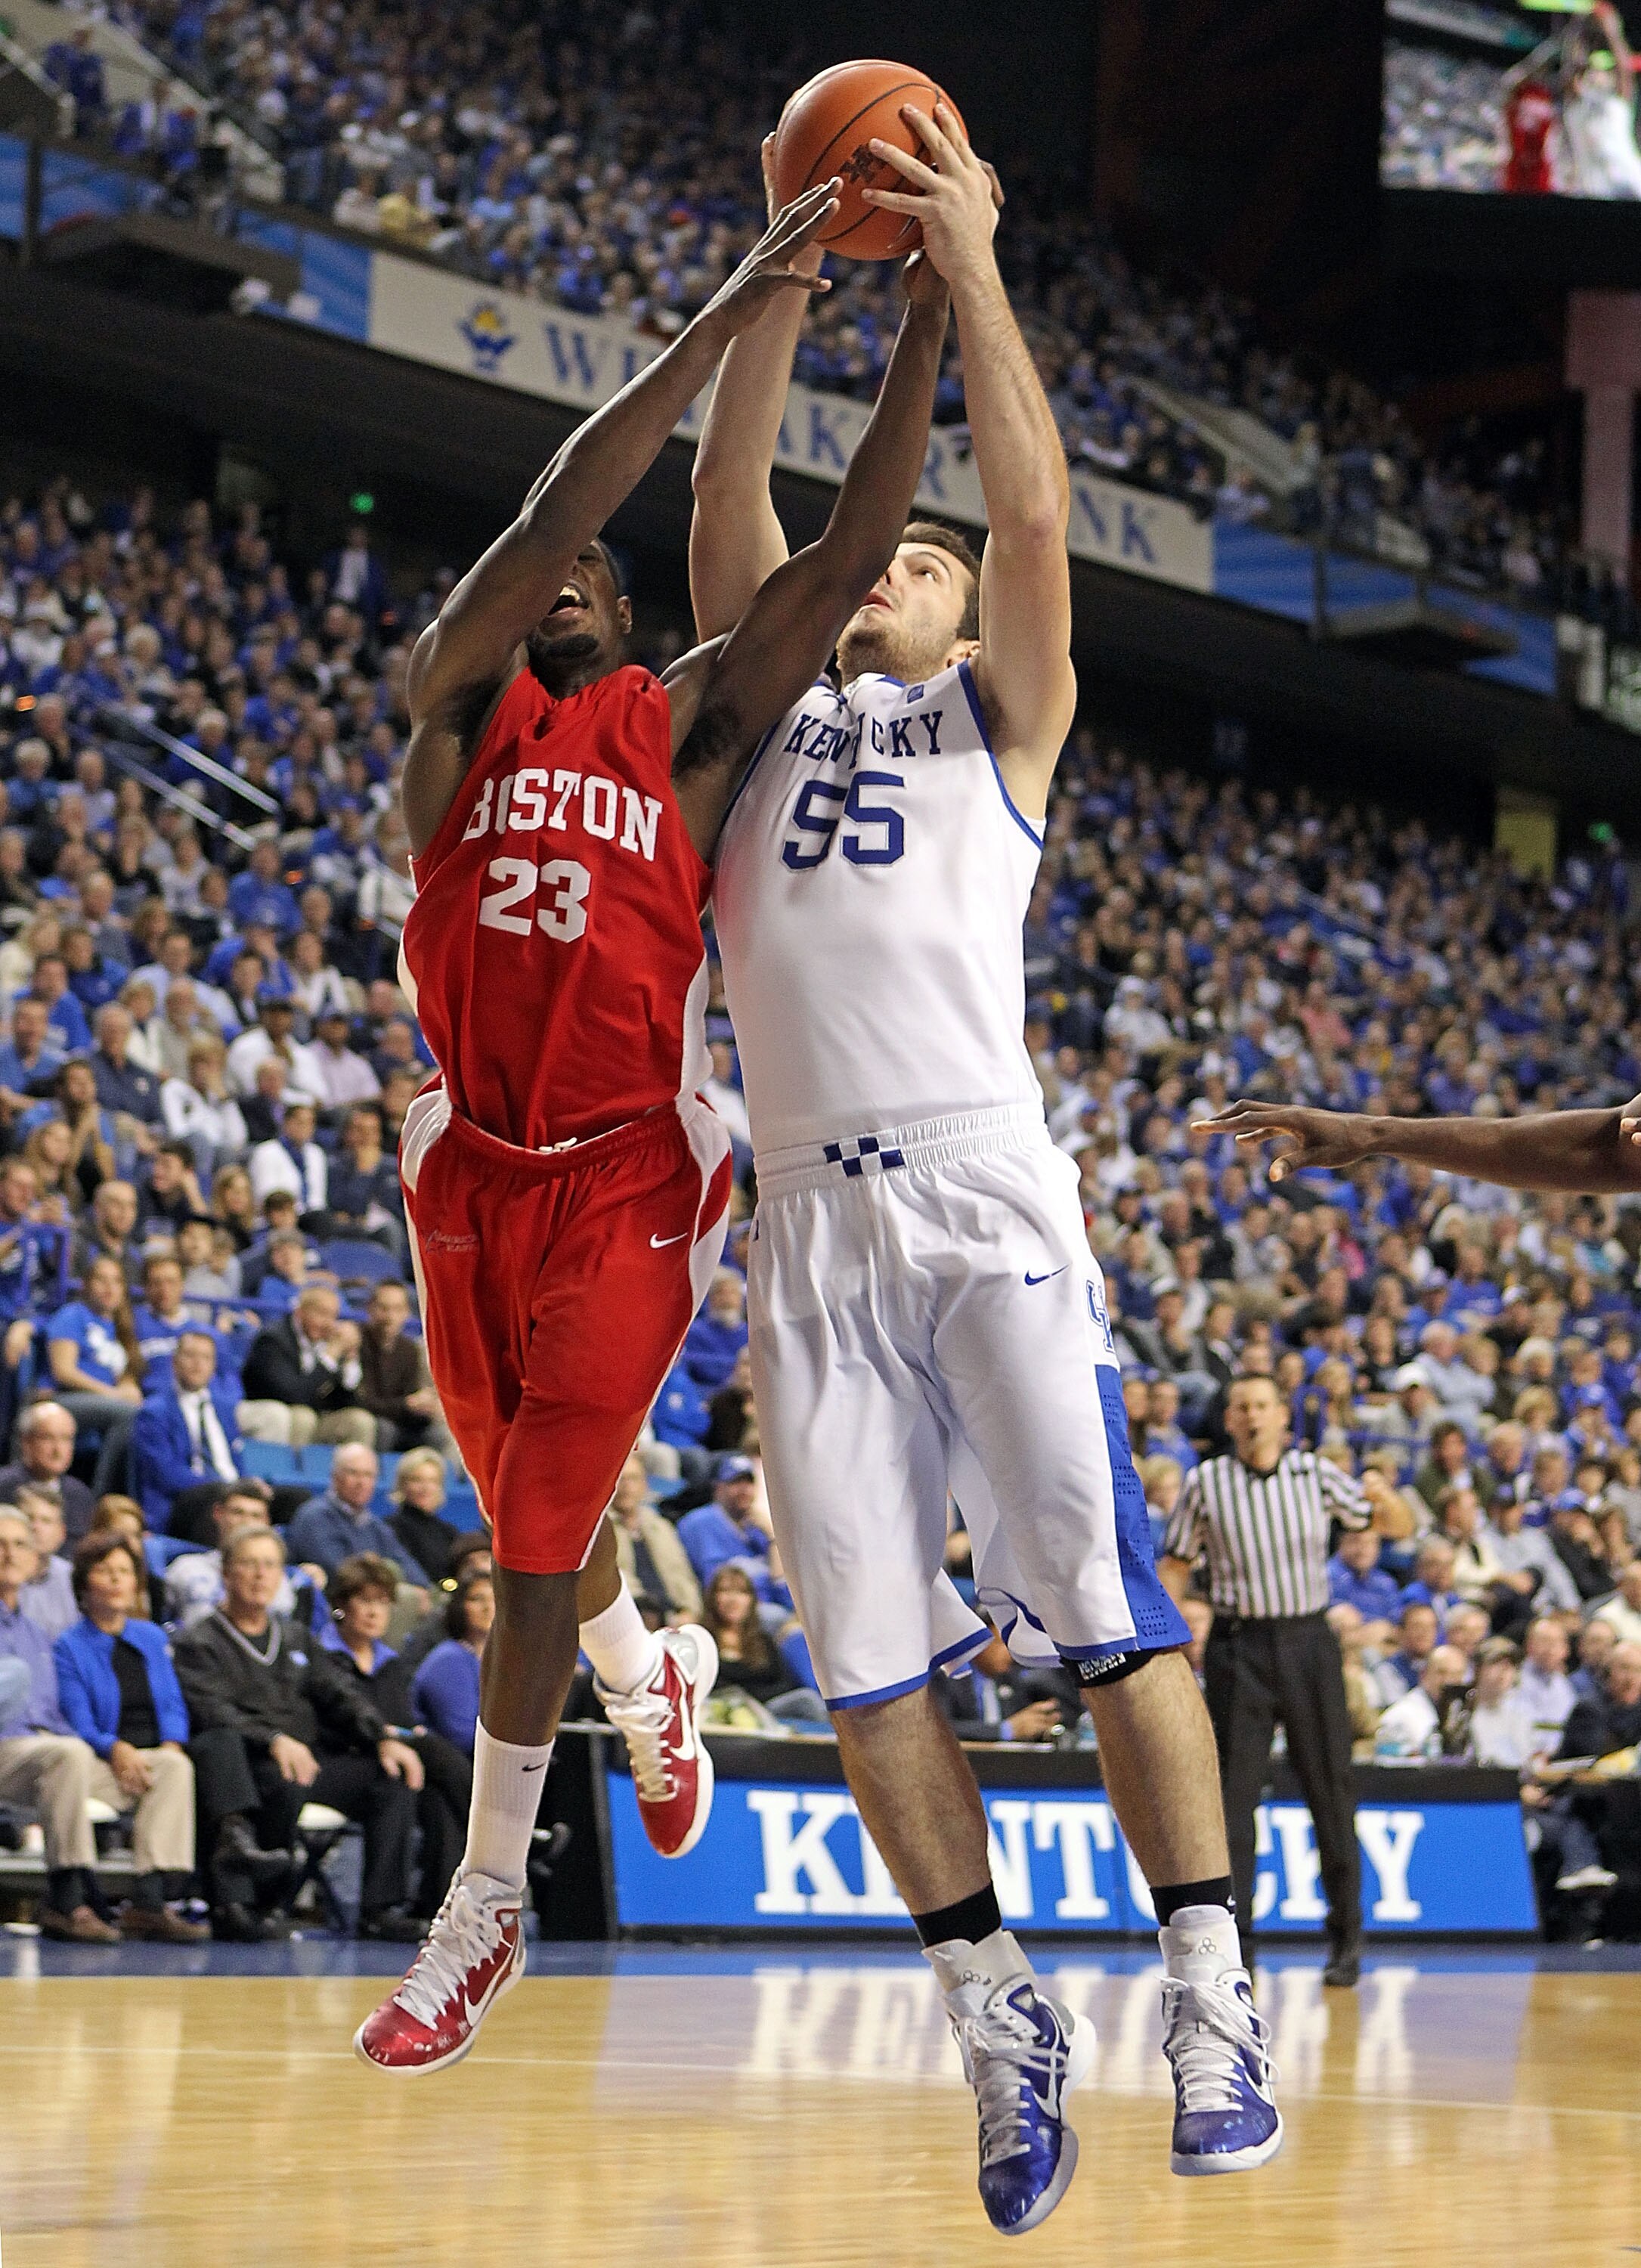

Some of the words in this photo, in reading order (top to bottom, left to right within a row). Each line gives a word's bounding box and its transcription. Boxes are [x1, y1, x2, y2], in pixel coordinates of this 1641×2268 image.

[783, 710, 943, 770] KENCKY
[781, 770, 906, 870] 55
[478, 857, 592, 943] 23
[746, 1789, 1426, 1923] KNTKY
